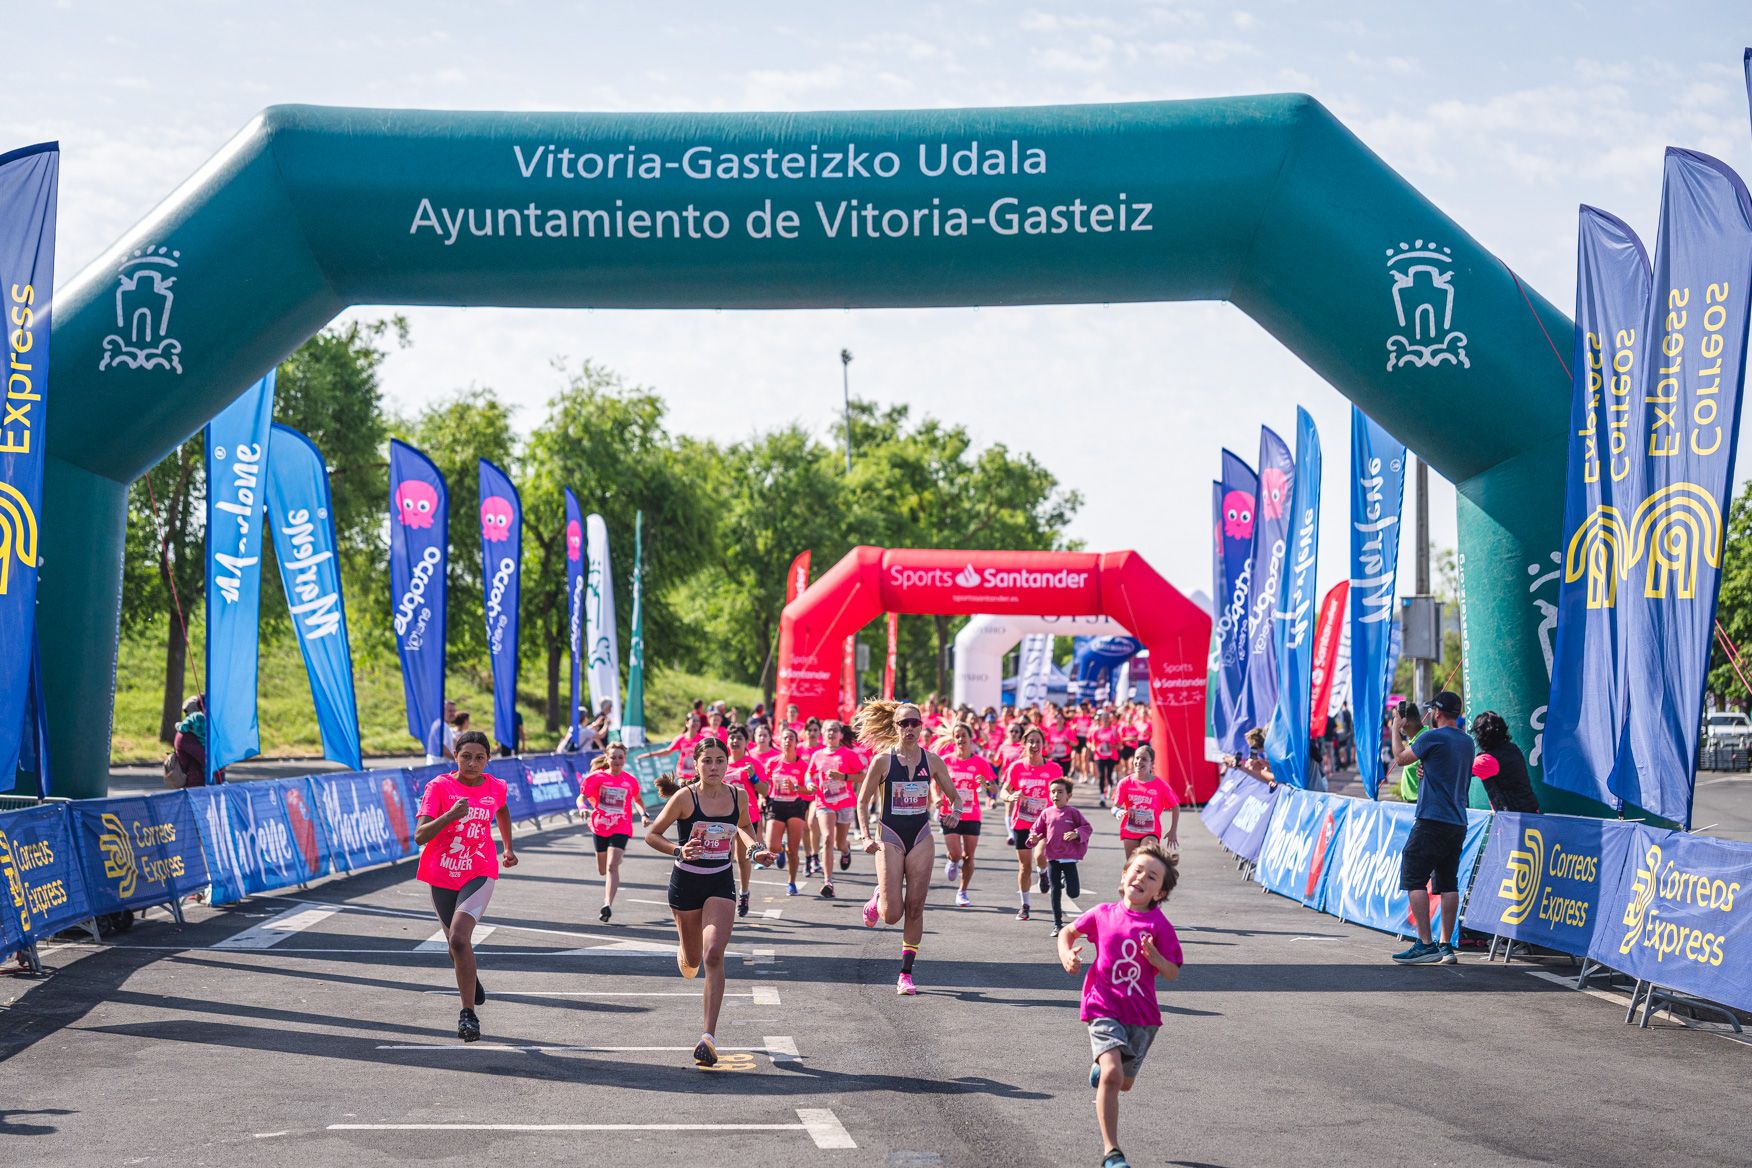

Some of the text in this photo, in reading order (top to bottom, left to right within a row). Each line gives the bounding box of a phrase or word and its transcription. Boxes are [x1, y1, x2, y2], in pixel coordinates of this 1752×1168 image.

[513, 140, 1047, 180] Vitoria-Gasteizko Udala
[409, 193, 1153, 245] Ayuntamiento de Vitoria-Gasteiz
[0, 283, 41, 454] Express
[890, 565, 1088, 590] Sports Santander
[1458, 553, 1472, 730] w.vitoria-gasteiz.org
[133, 820, 176, 848] Correos
[323, 780, 390, 871] Marlene
[13, 839, 55, 872] Correos
[141, 854, 185, 887] Express
[440, 854, 472, 870] MUJER
[1337, 800, 1402, 918] Marlen
[1549, 843, 1598, 883] Correos
[25, 879, 68, 919] Express
[1659, 859, 1741, 912] Correos
[1539, 886, 1590, 930] Express
[1643, 908, 1726, 967] Express
